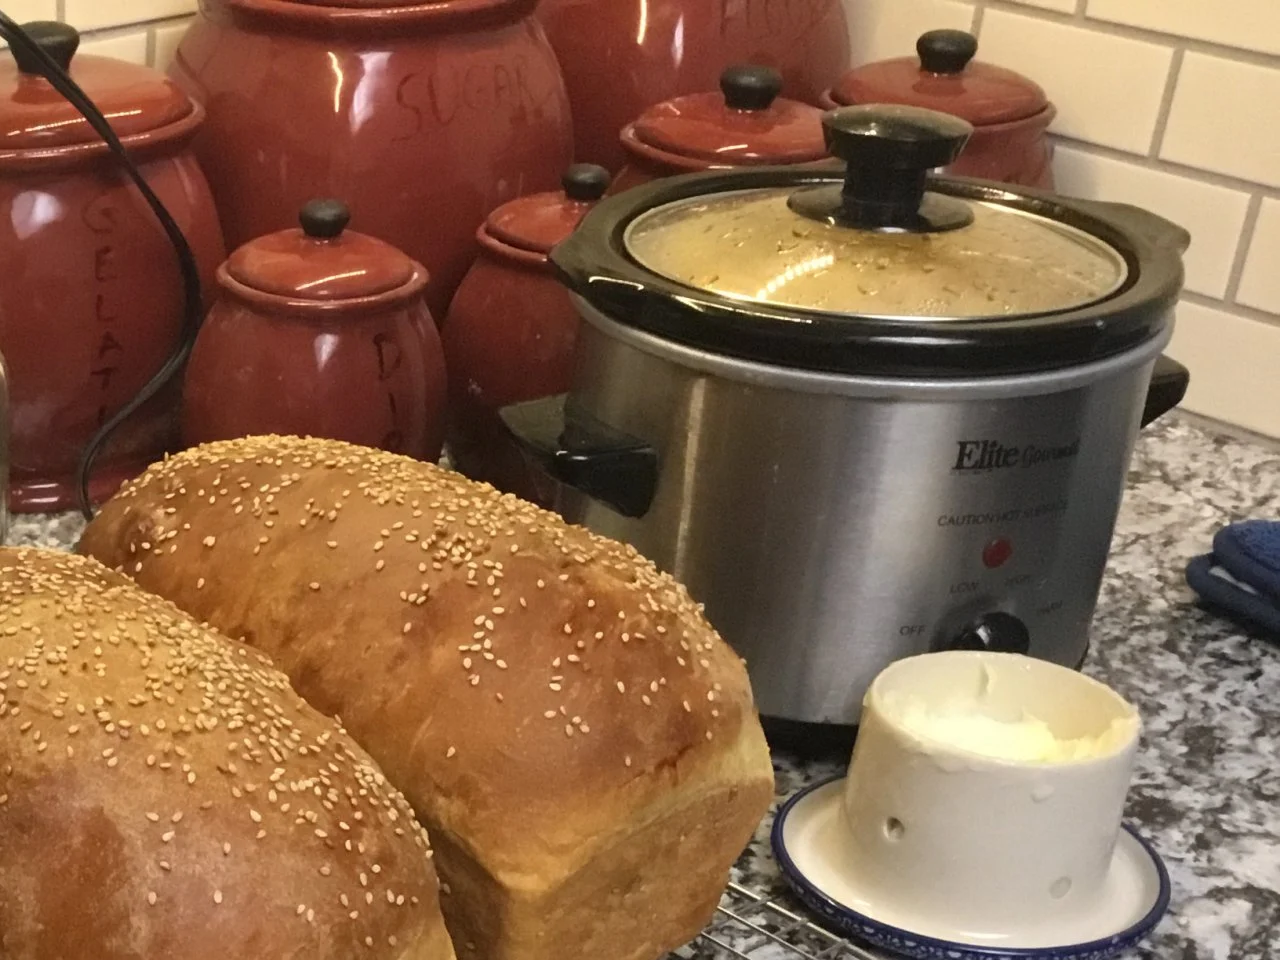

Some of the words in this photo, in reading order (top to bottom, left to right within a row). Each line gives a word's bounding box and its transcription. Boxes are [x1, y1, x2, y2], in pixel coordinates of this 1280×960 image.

[952, 440, 1020, 470] Elite
[937, 512, 993, 527] CAUTION
[950, 581, 979, 595] LOW
[899, 625, 926, 638] OFF
